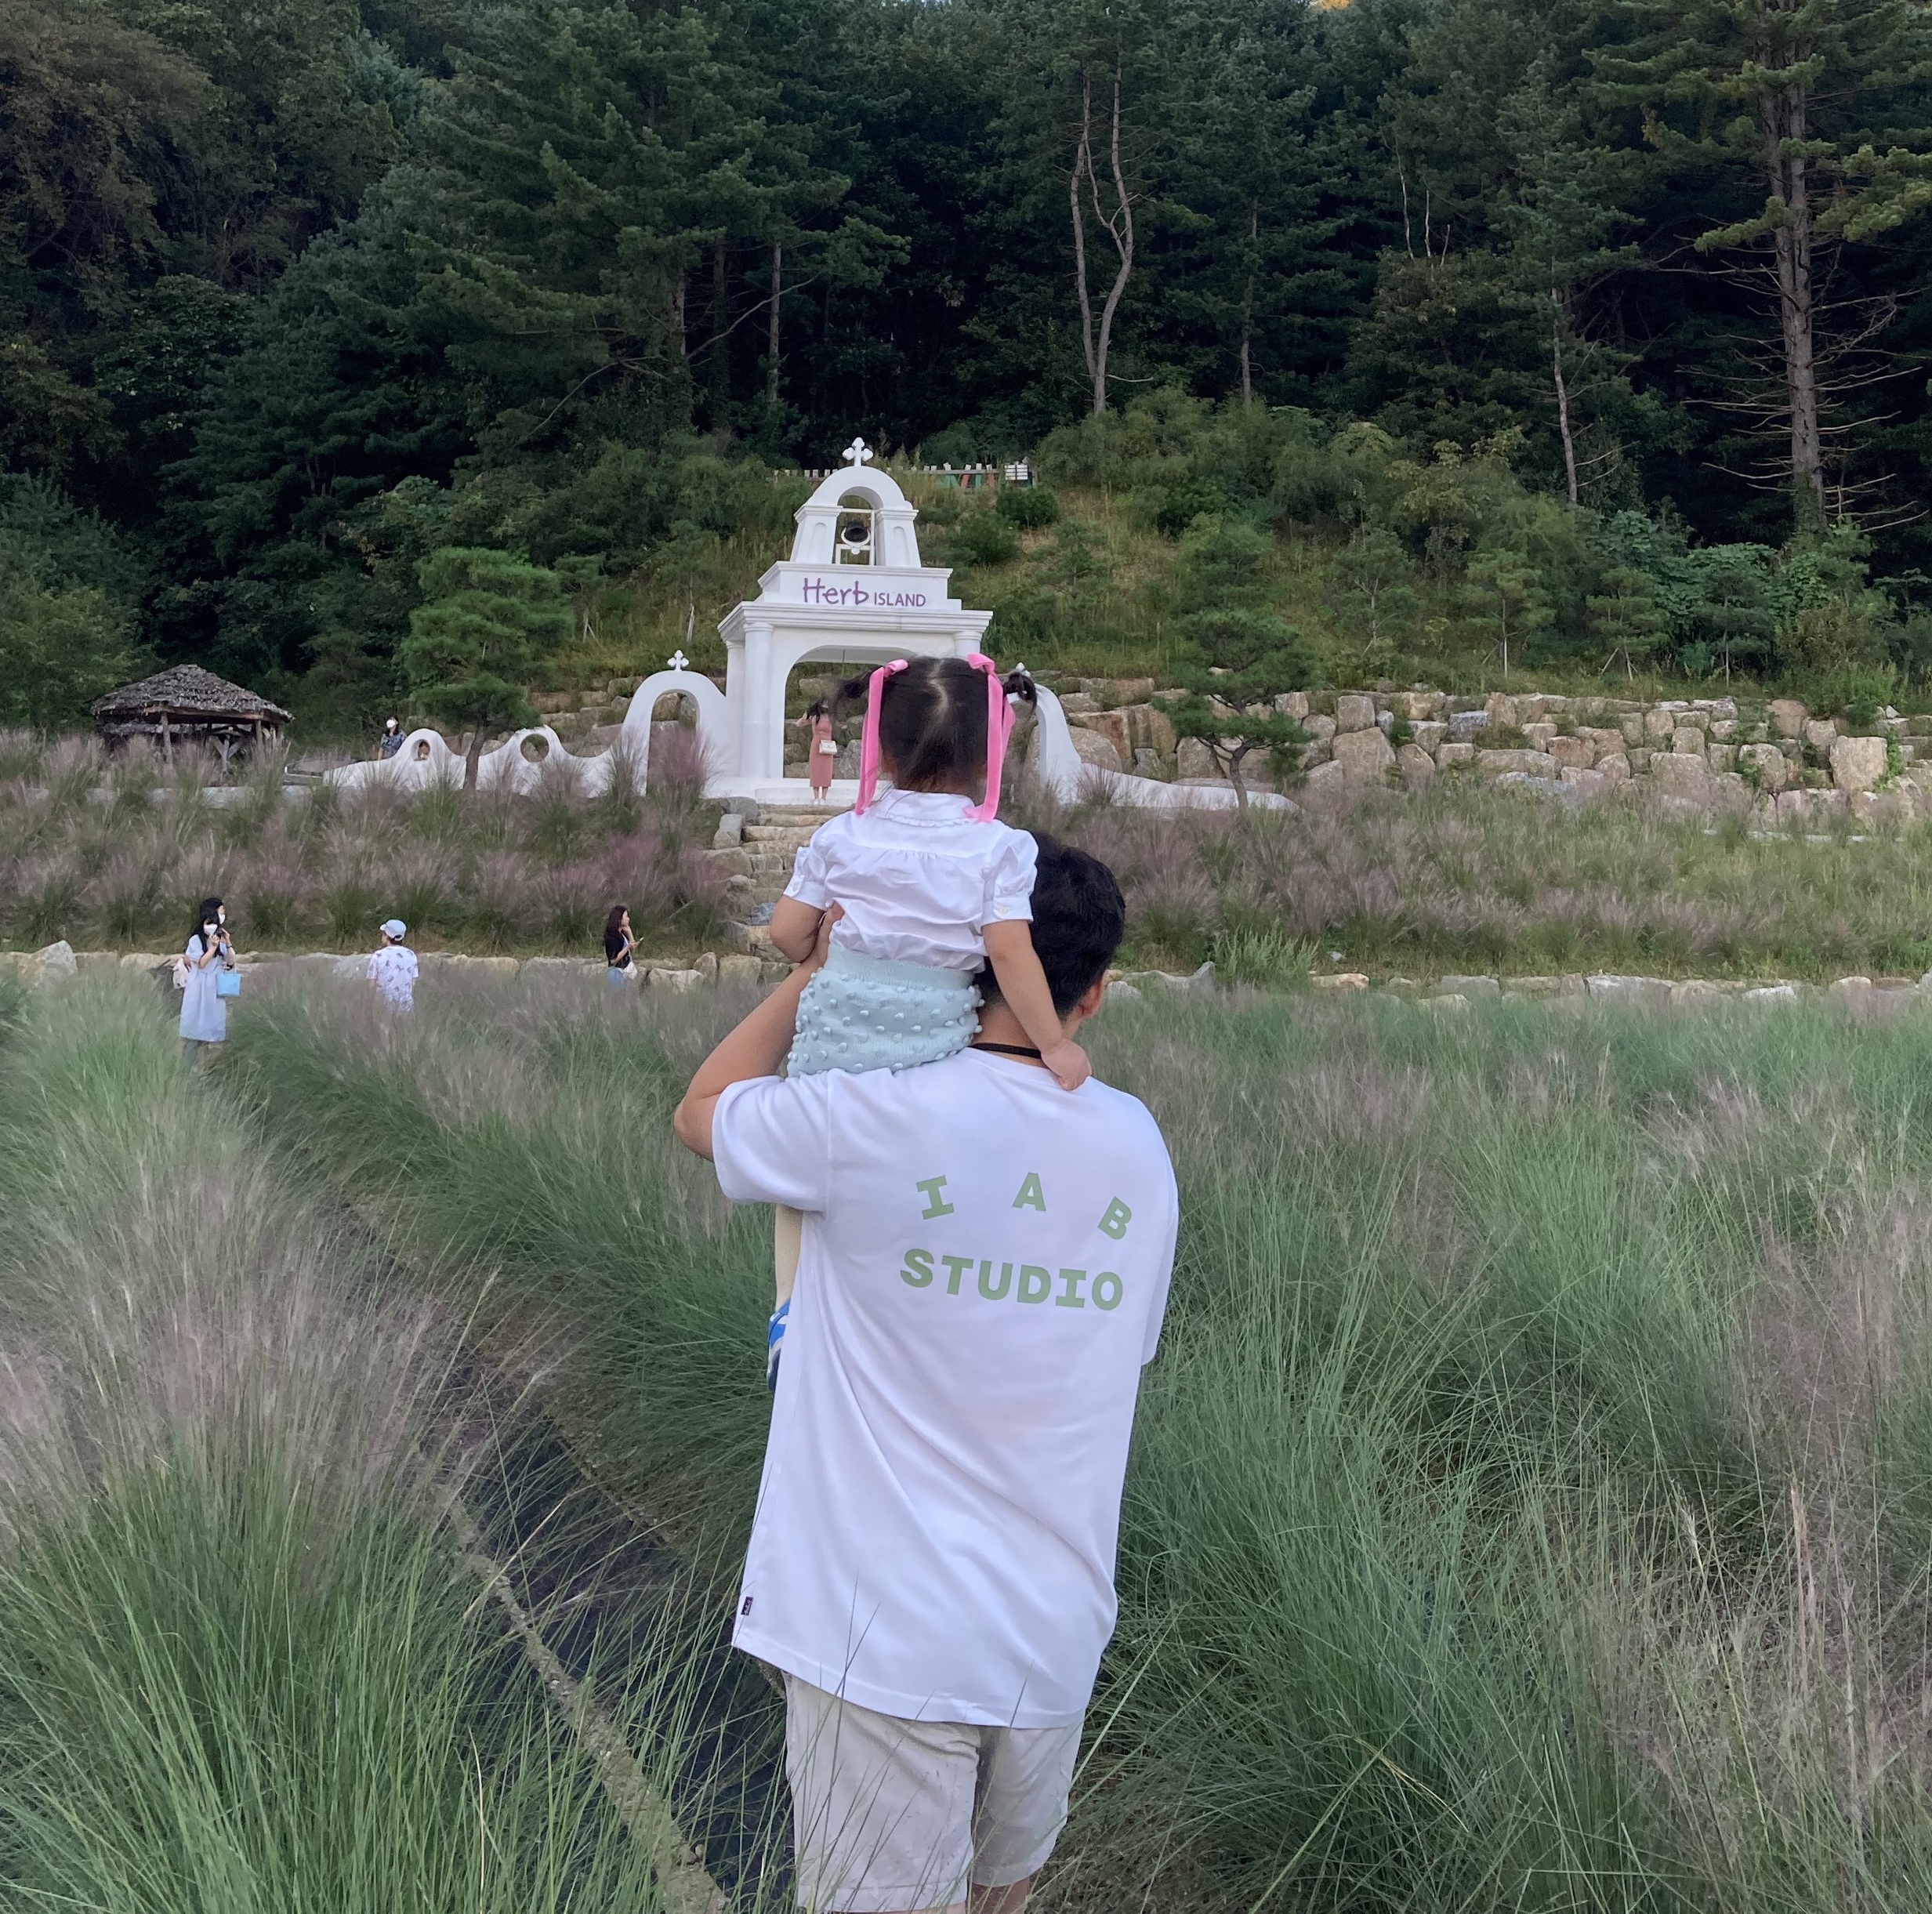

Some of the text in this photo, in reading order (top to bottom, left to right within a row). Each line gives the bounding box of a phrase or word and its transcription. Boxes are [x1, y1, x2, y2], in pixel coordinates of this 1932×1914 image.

[803, 578, 926, 607] Herb ISLAND
[901, 1248, 1123, 1311] STUDIO
